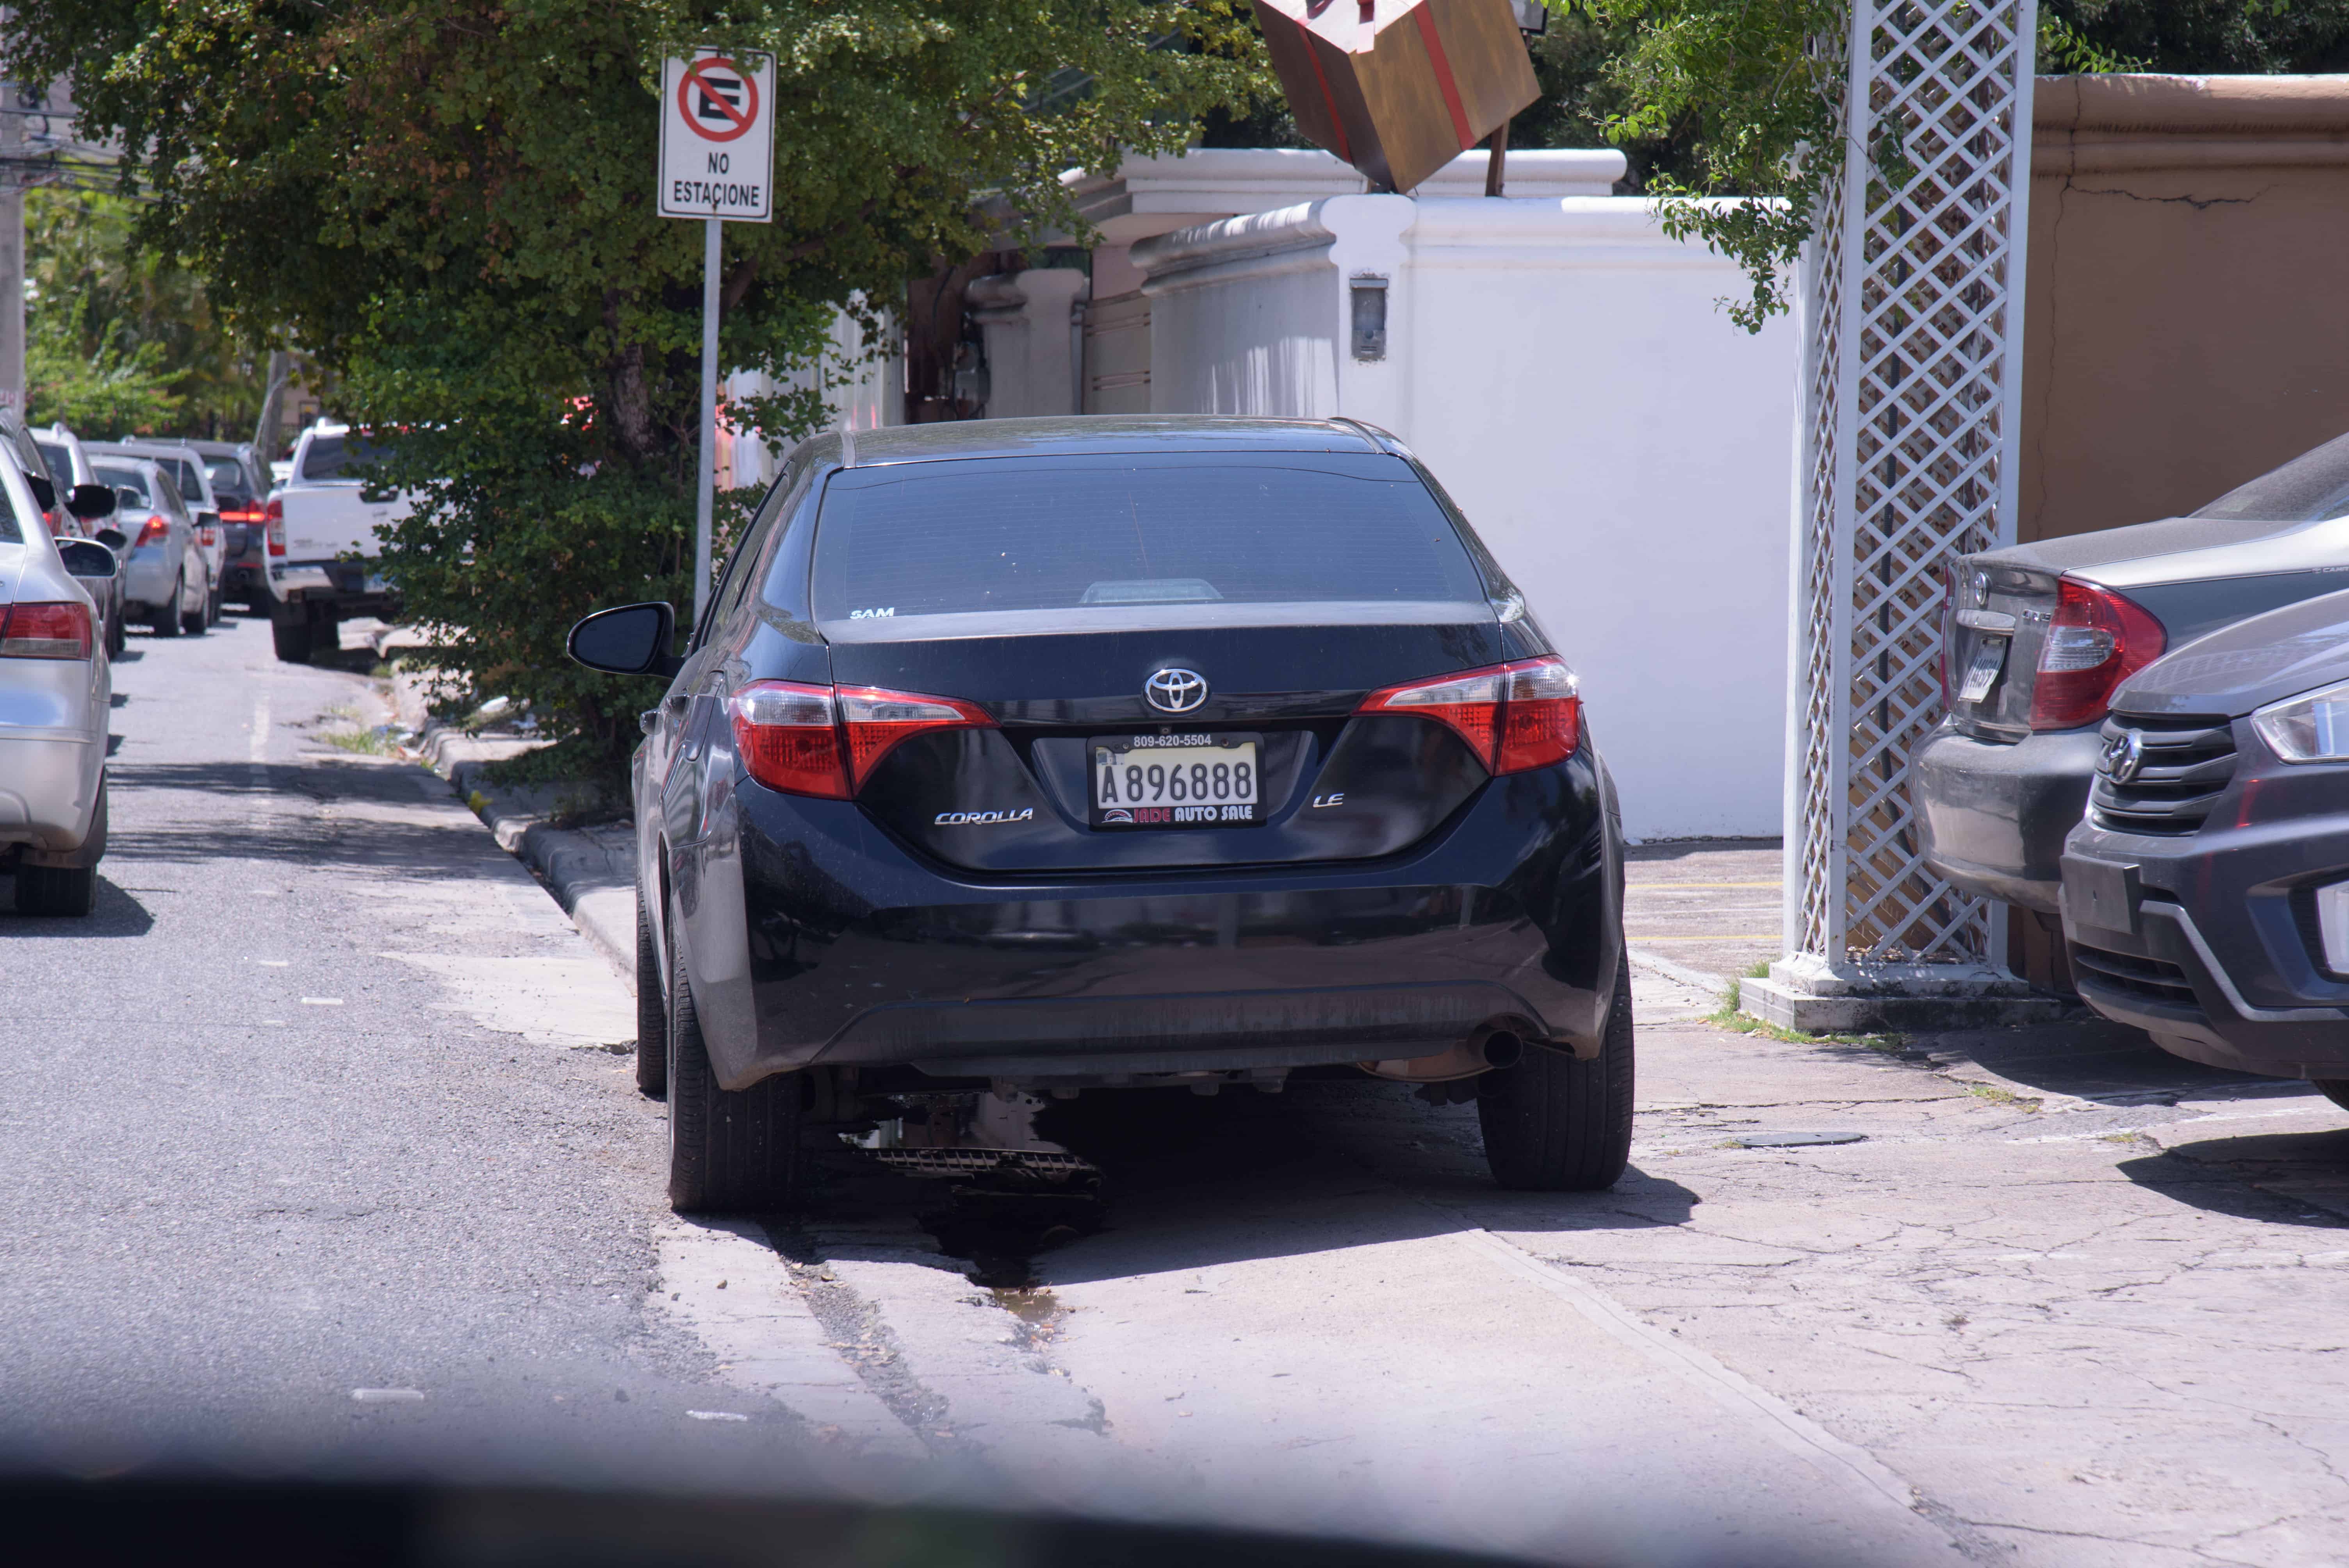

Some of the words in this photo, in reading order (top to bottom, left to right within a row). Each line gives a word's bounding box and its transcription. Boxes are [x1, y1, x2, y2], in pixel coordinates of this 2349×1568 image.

[708, 152, 729, 174] NO
[674, 181, 759, 207] ESTACIONE
[850, 607, 895, 619] SAM
[1134, 734, 1211, 747] 809-620-5504
[1101, 762, 1251, 802] A896888
[1313, 793, 1344, 808] LE
[934, 807, 1033, 825] COROLLA
[1133, 808, 1171, 823] JADE
[1174, 806, 1217, 821] AUTO
[1221, 805, 1253, 820] SALE
